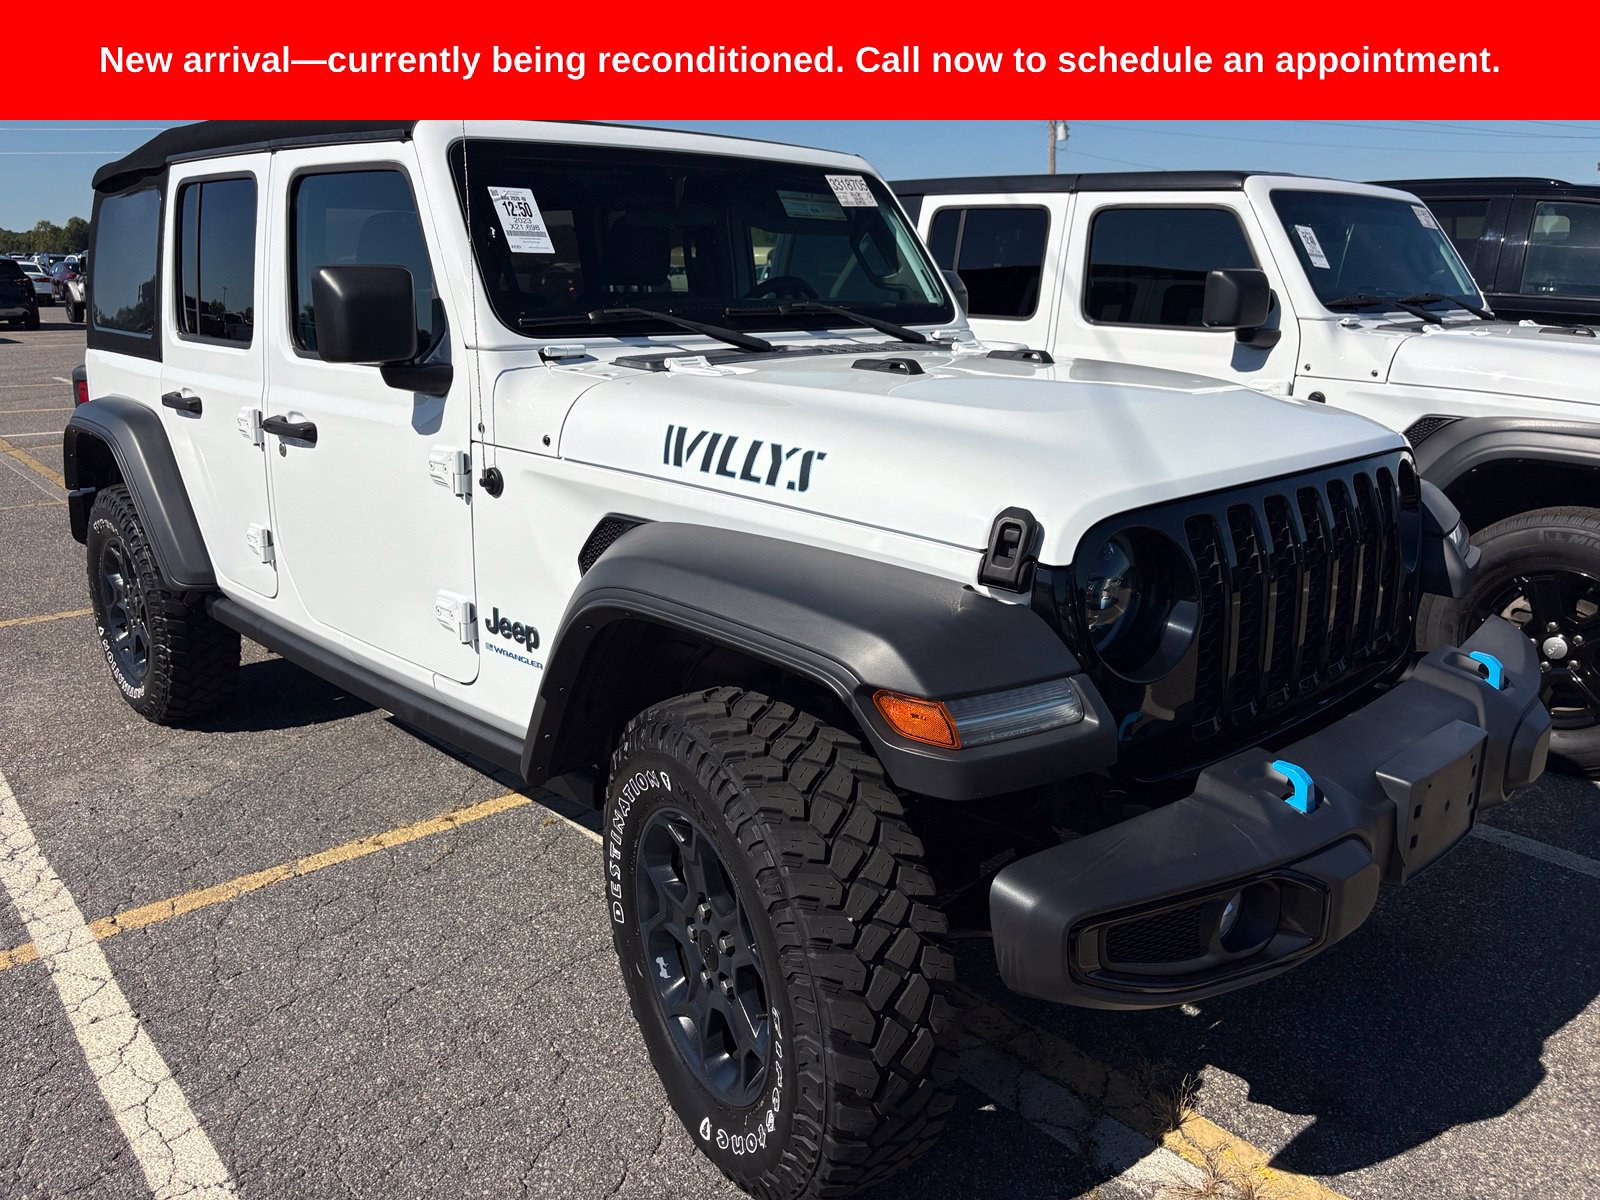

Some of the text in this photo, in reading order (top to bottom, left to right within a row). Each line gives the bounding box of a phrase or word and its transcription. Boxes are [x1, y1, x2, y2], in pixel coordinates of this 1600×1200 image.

[829, 178, 868, 191] 3318705
[502, 201, 533, 217] 12:50
[663, 424, 827, 492] WILLYS
[485, 606, 540, 654] Jeep
[493, 645, 544, 670] WRANGLER
[609, 770, 660, 924] DESTINATION
